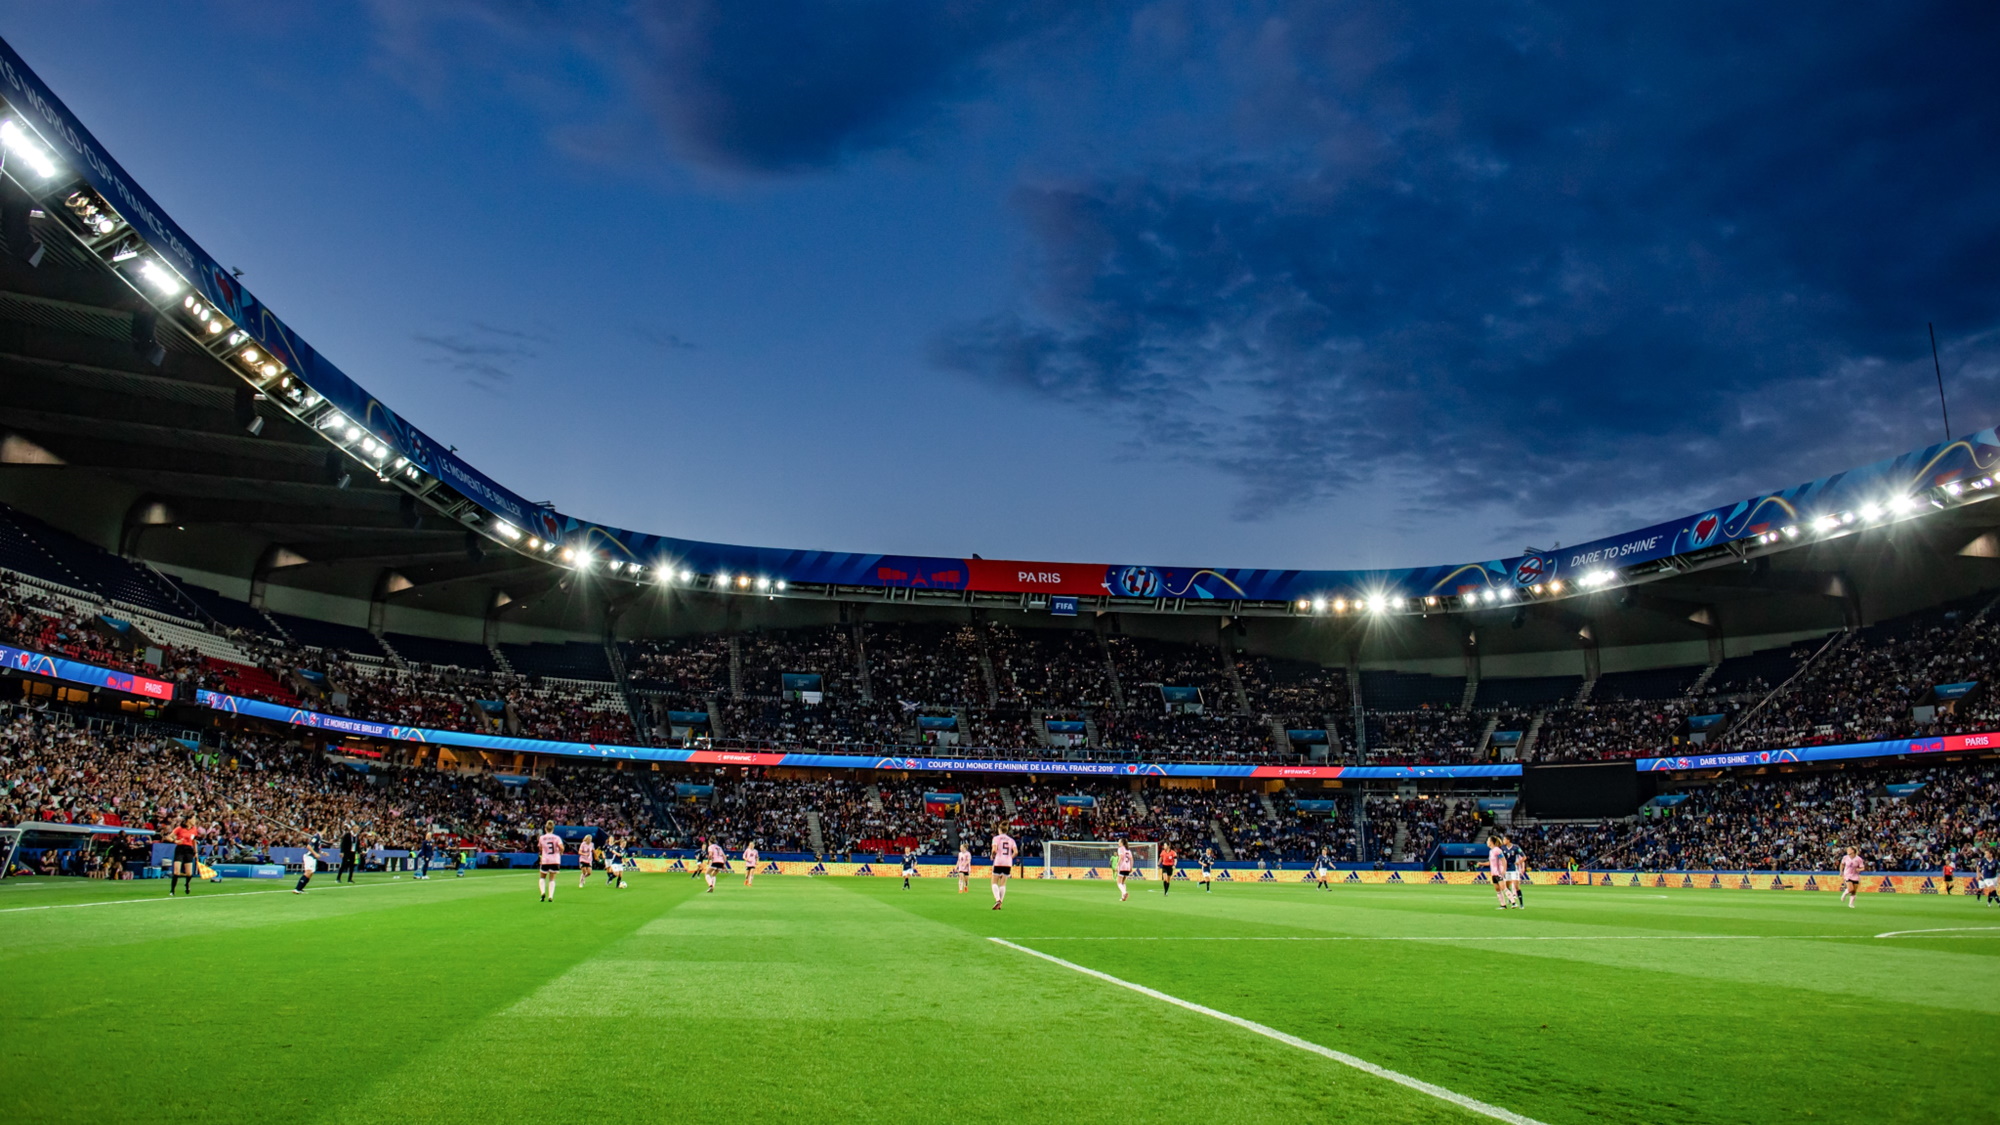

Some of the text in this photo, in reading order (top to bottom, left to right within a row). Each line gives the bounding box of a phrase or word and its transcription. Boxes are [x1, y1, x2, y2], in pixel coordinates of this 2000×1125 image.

[18, 73, 83, 155] WORLD
[83, 143, 114, 186] CUP
[113, 175, 168, 243] FRANCE
[438, 455, 523, 518] LE MOMENT DE BRILLER
[1570, 537, 1657, 568] DARE TO SHINE
[1018, 571, 1061, 583] PARIS
[1056, 602, 1073, 611] FIFA
[144, 682, 163, 695] PARIS
[323, 718, 383, 735] LE MOMENT DE BRILLER
[1964, 735, 1990, 747] PARIS
[927, 760, 953, 769] COUPE
[954, 761, 965, 769] DU
[966, 761, 994, 770] MONDE
[995, 760, 1028, 771] FÉMININE
[1029, 763, 1040, 771] DE
[1041, 763, 1051, 771] LA
[1069, 764, 1097, 773] FRANCE
[1098, 765, 1114, 773] 2019
[1699, 755, 1747, 767] DARE TO SHINE
[546, 841, 555, 855] 3
[1002, 841, 1010, 856] 5
